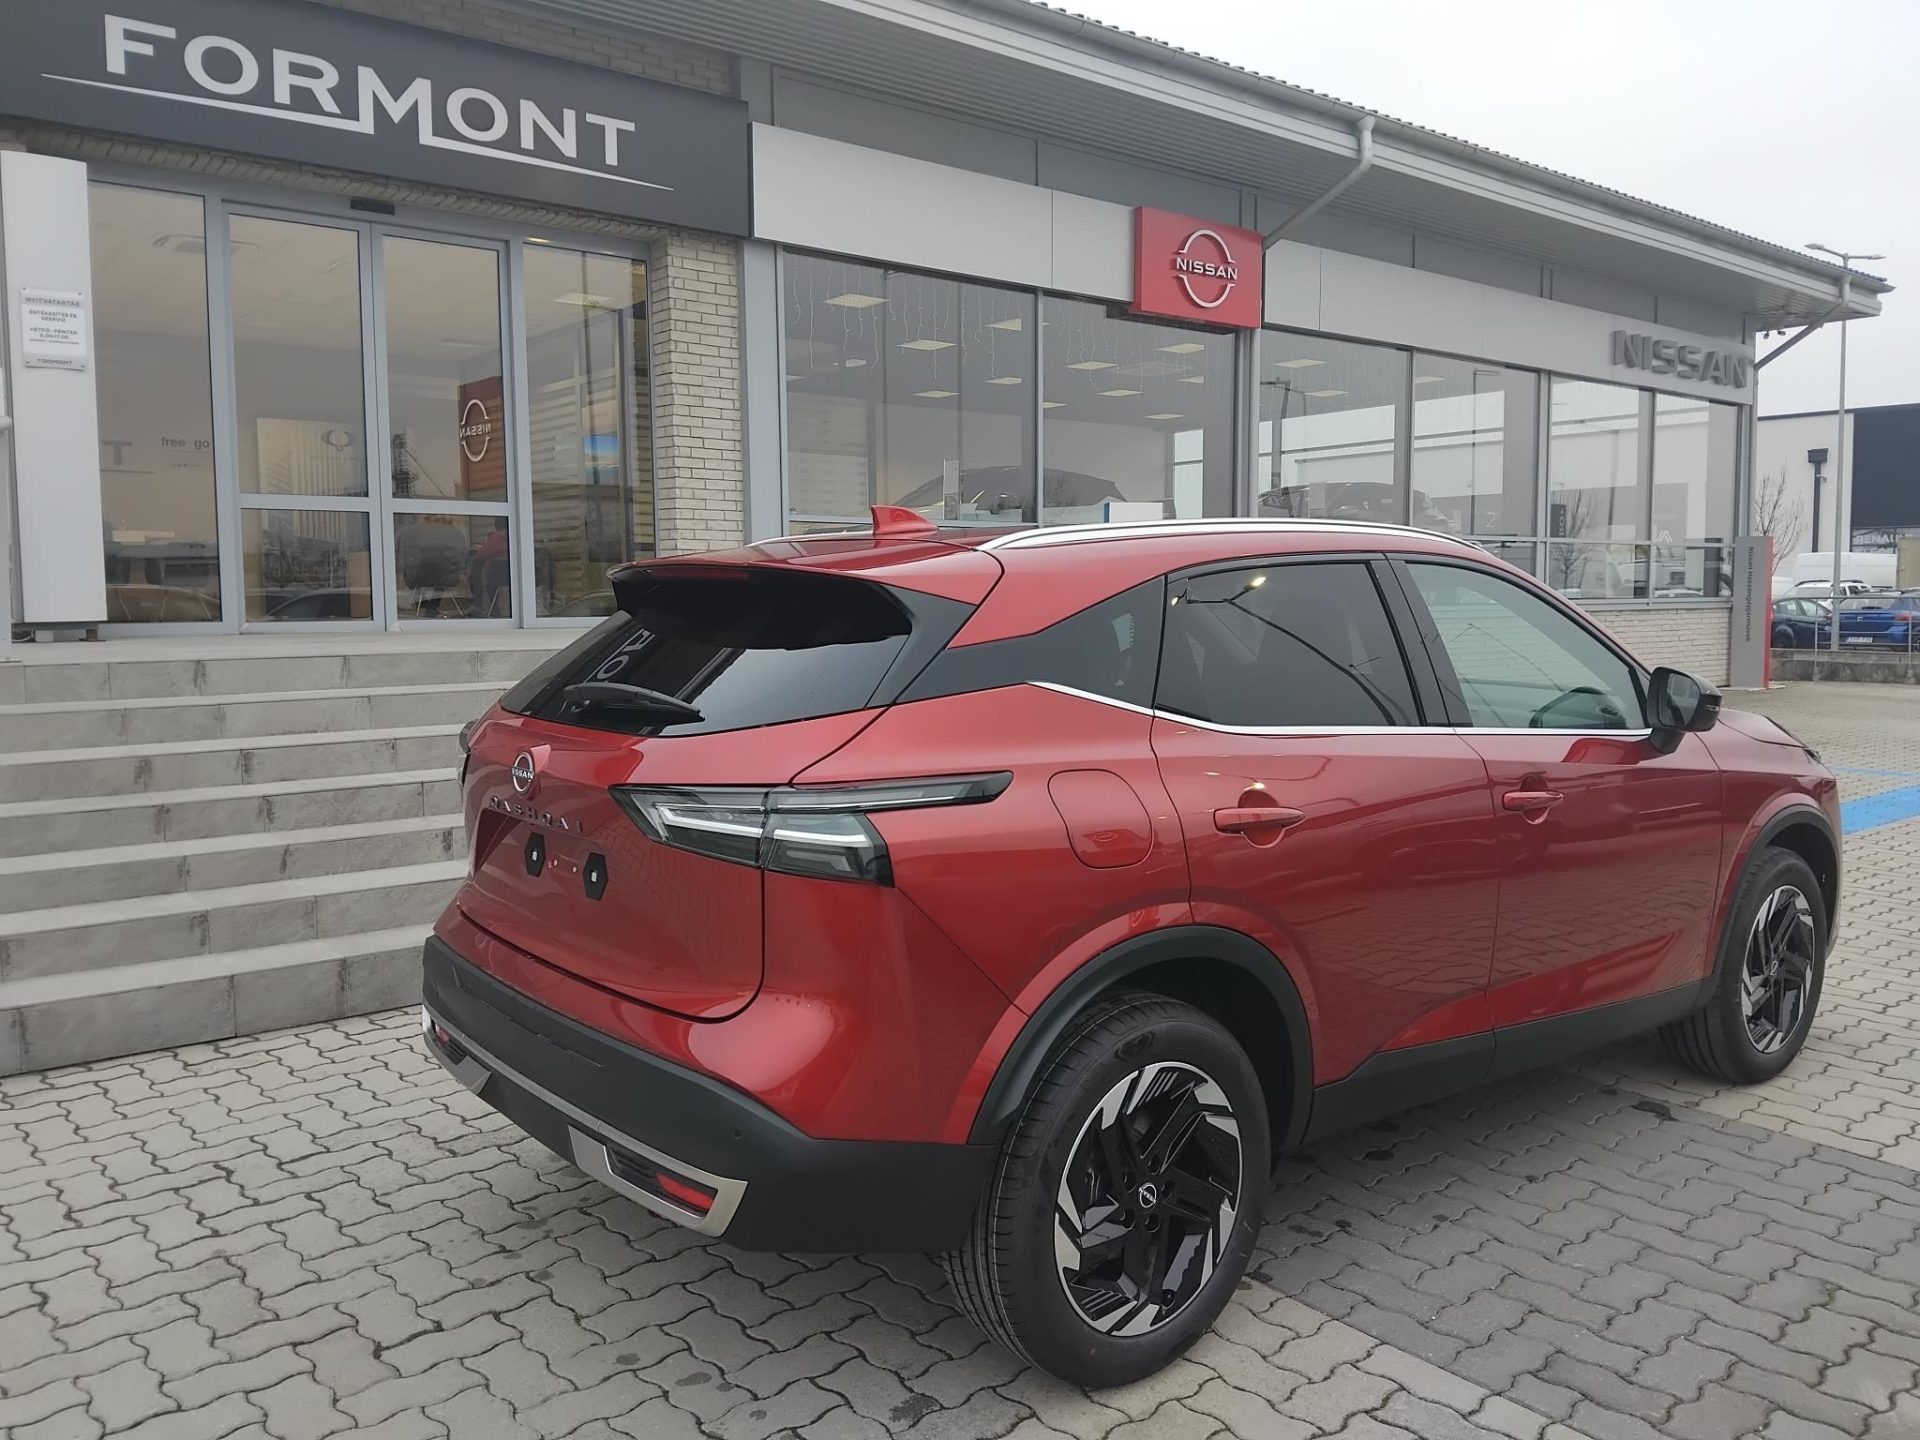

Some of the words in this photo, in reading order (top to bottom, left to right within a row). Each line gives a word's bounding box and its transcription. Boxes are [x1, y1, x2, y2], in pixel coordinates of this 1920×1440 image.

[104, 14, 636, 167] FORMONT
[1176, 257, 1238, 280] NISSAN
[1612, 329, 1750, 389] NISSAN
[160, 436, 186, 448] free
[489, 795, 584, 833] QASHQAI
